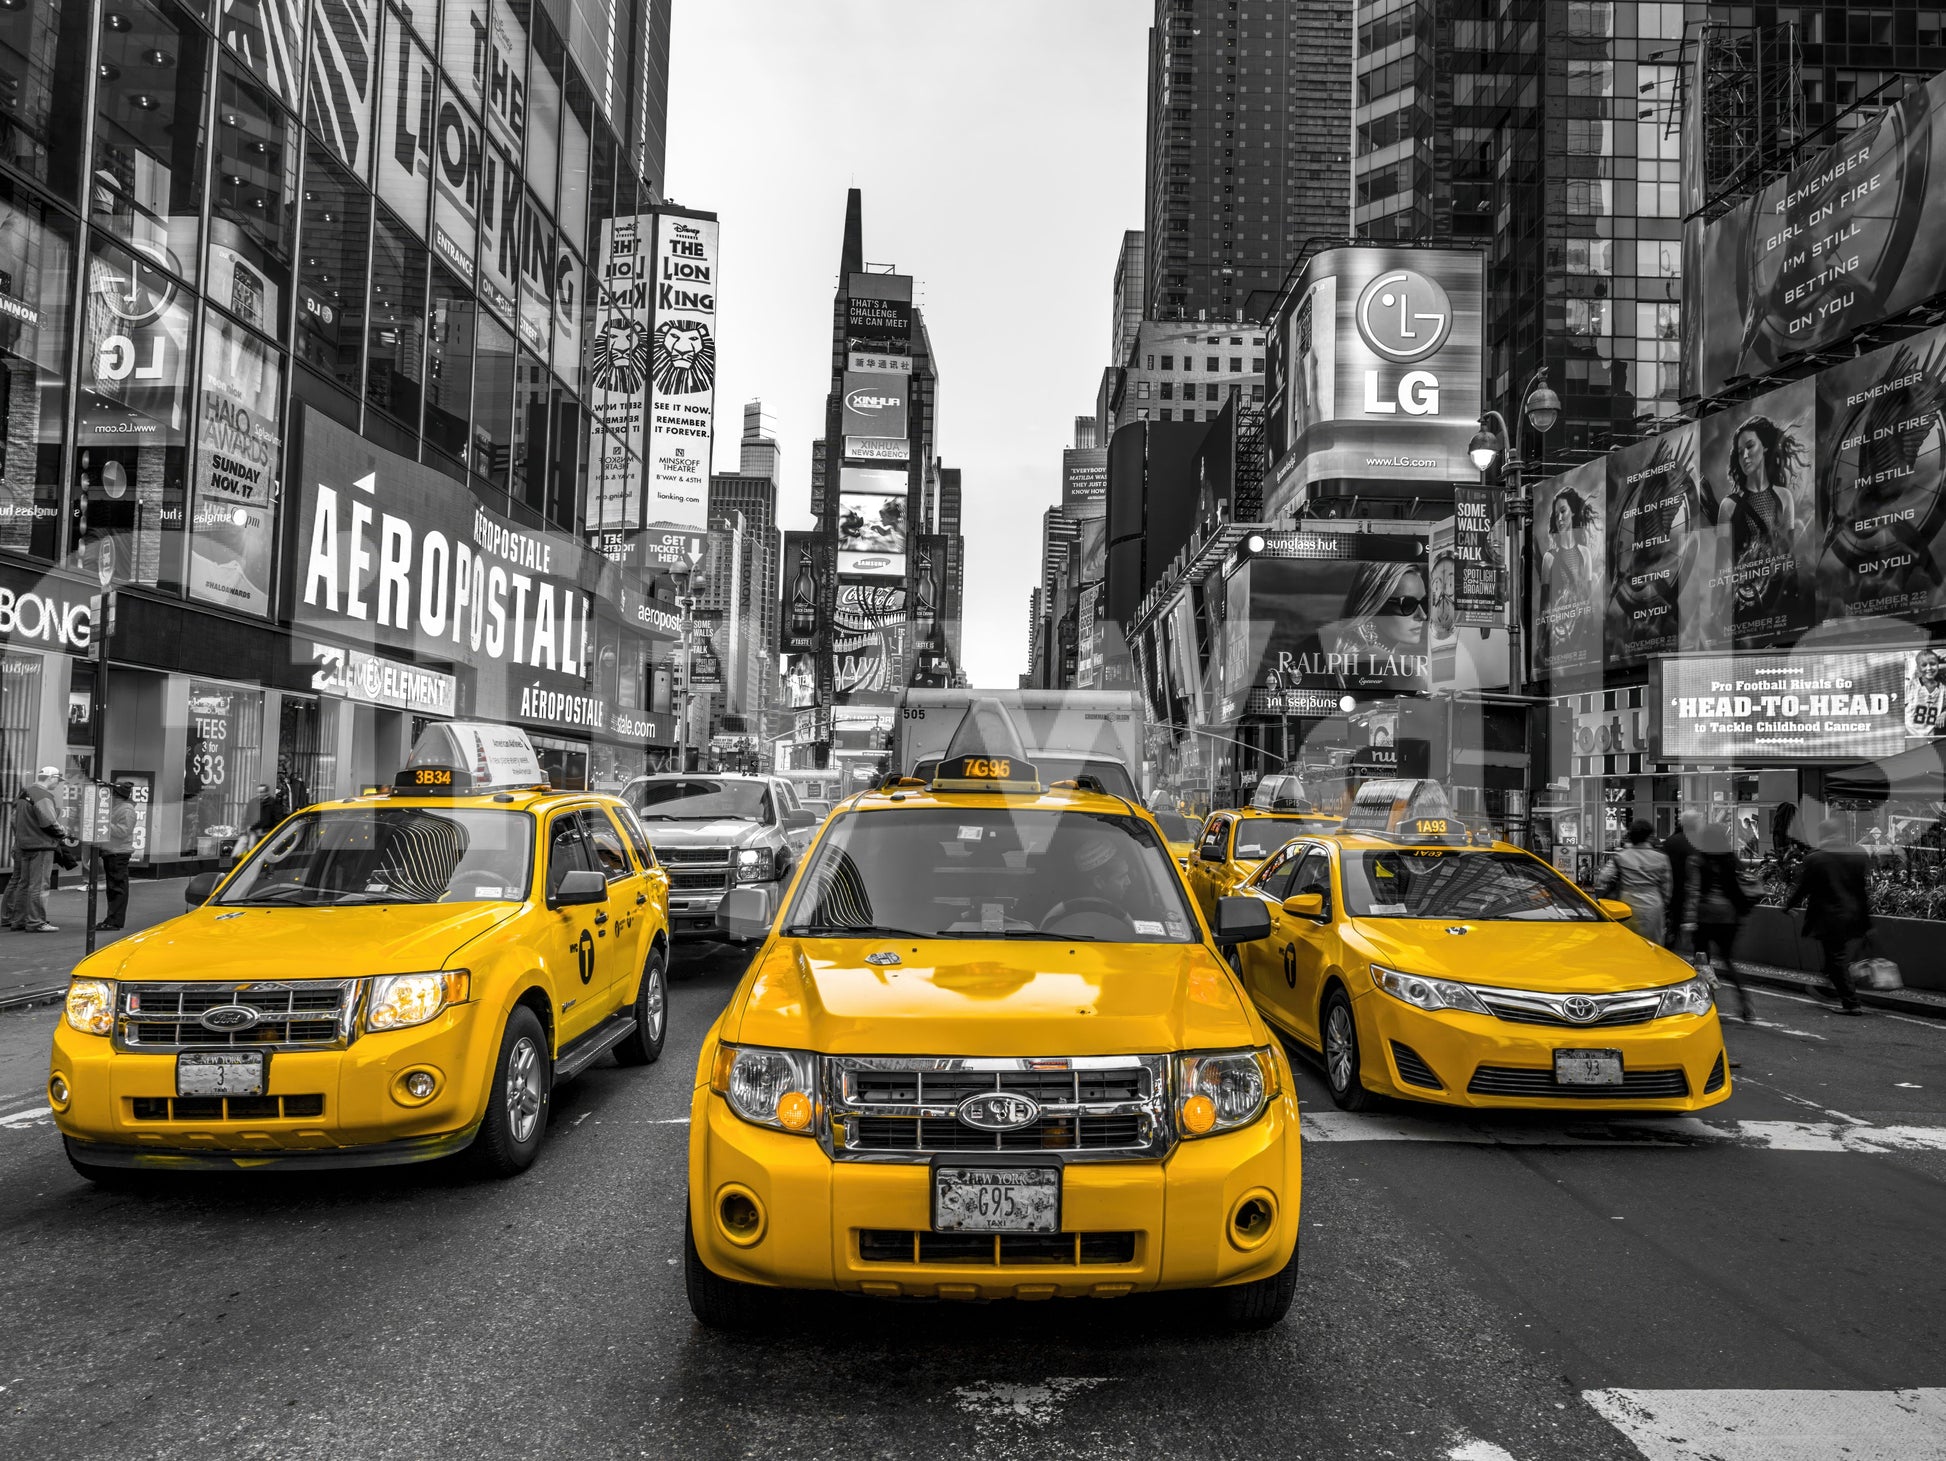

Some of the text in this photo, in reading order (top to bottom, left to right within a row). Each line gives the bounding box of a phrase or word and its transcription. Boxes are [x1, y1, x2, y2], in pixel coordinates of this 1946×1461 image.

[1776, 147, 1870, 214] REMEMBER
[1767, 174, 1880, 251] GIRL ON FIRE
[672, 222, 700, 236] Disney
[437, 230, 473, 277] ENTRANCE
[669, 239, 704, 257] THE
[1783, 223, 1860, 273] I'M STILL
[664, 256, 711, 281] LION
[1785, 255, 1859, 304] BETTING
[482, 279, 493, 297] ON
[659, 282, 715, 311] KING
[851, 299, 888, 309] THAT'S A
[850, 308, 897, 319] CHALLENGE
[1789, 291, 1854, 335] ON YOU
[850, 317, 908, 328] WE CAN MEET
[855, 358, 910, 370] 新华通讯社
[1364, 370, 1440, 415] LG
[1847, 371, 1924, 407] REMEMBER
[654, 402, 711, 415] SEE IT NOW.
[853, 395, 900, 407] XINHUA
[656, 416, 706, 428] REMEMBER
[655, 426, 710, 438] IT FOREVER.
[1841, 414, 1930, 451] GIRL ON FIRE
[861, 441, 900, 451] XINHUA
[659, 457, 700, 467] MINSKOFF
[852, 450, 908, 459] NEWS AGENCY
[1366, 457, 1436, 468] www.LG.com
[212, 454, 261, 484] SUNDAY
[663, 464, 696, 473] THEATRE
[1626, 461, 1677, 485] REMEMBER
[211, 472, 253, 499] NOV. 17
[1854, 465, 1915, 490] I'M STILL
[657, 492, 700, 504] lionking.com
[1457, 503, 1487, 518] SOME
[1623, 496, 1680, 520] GIRL ON FIRE
[1457, 518, 1490, 532] WALLS
[1854, 508, 1915, 532] BETTING
[474, 506, 551, 574] AÉROPOSTALE
[662, 535, 686, 546] GET
[1267, 537, 1337, 551] sunglass hut
[1457, 532, 1478, 546] CAN
[1631, 534, 1670, 551] I'M STILL
[1457, 546, 1482, 560] TALK
[1720, 554, 1792, 575] THE HUNGER GAMES
[1858, 553, 1912, 574] ON YOU
[1463, 569, 1496, 582] SPOTLIGHT
[1631, 569, 1670, 587] BETTING
[1708, 560, 1802, 589] CATCHING FIRE
[205, 581, 251, 599] #HALOAWARDS
[1463, 582, 1496, 595] BROADWAY
[1845, 590, 1928, 611] NOVEMBER 22
[1535, 609, 1576, 626] CATCHING
[1634, 605, 1667, 620] ON YOU
[1723, 614, 1787, 632] NOVEMBER 22
[693, 628, 714, 637] WALLS
[692, 645, 708, 654] TALK
[1625, 637, 1665, 650] NOVEMBER
[1667, 635, 1677, 644] 22
[1278, 651, 1358, 676] RALPH
[383, 667, 446, 706] ELEMENT
[1711, 678, 1853, 692] Pro Football Rivals Go
[521, 680, 604, 728] AÉROPOSTALE
[903, 709, 925, 720] 505
[1914, 706, 1937, 725] 88
[195, 718, 227, 739] TEES
[1695, 720, 1871, 733] to Tackle Childhood Cancer
[202, 741, 219, 752] 3 for
[193, 755, 225, 784] $33
[963, 758, 1010, 777] 7G95
[415, 770, 451, 784] 3B34
[1416, 820, 1447, 832] 1A93
[213, 1012, 241, 1024] Ford
[200, 1055, 242, 1065] NEW YORK
[1585, 1060, 1600, 1076] 93
[217, 1065, 225, 1086] 3
[996, 1173, 1029, 1184] YORK
[978, 1187, 1015, 1217] G95
[986, 1219, 1006, 1227] TAXI
